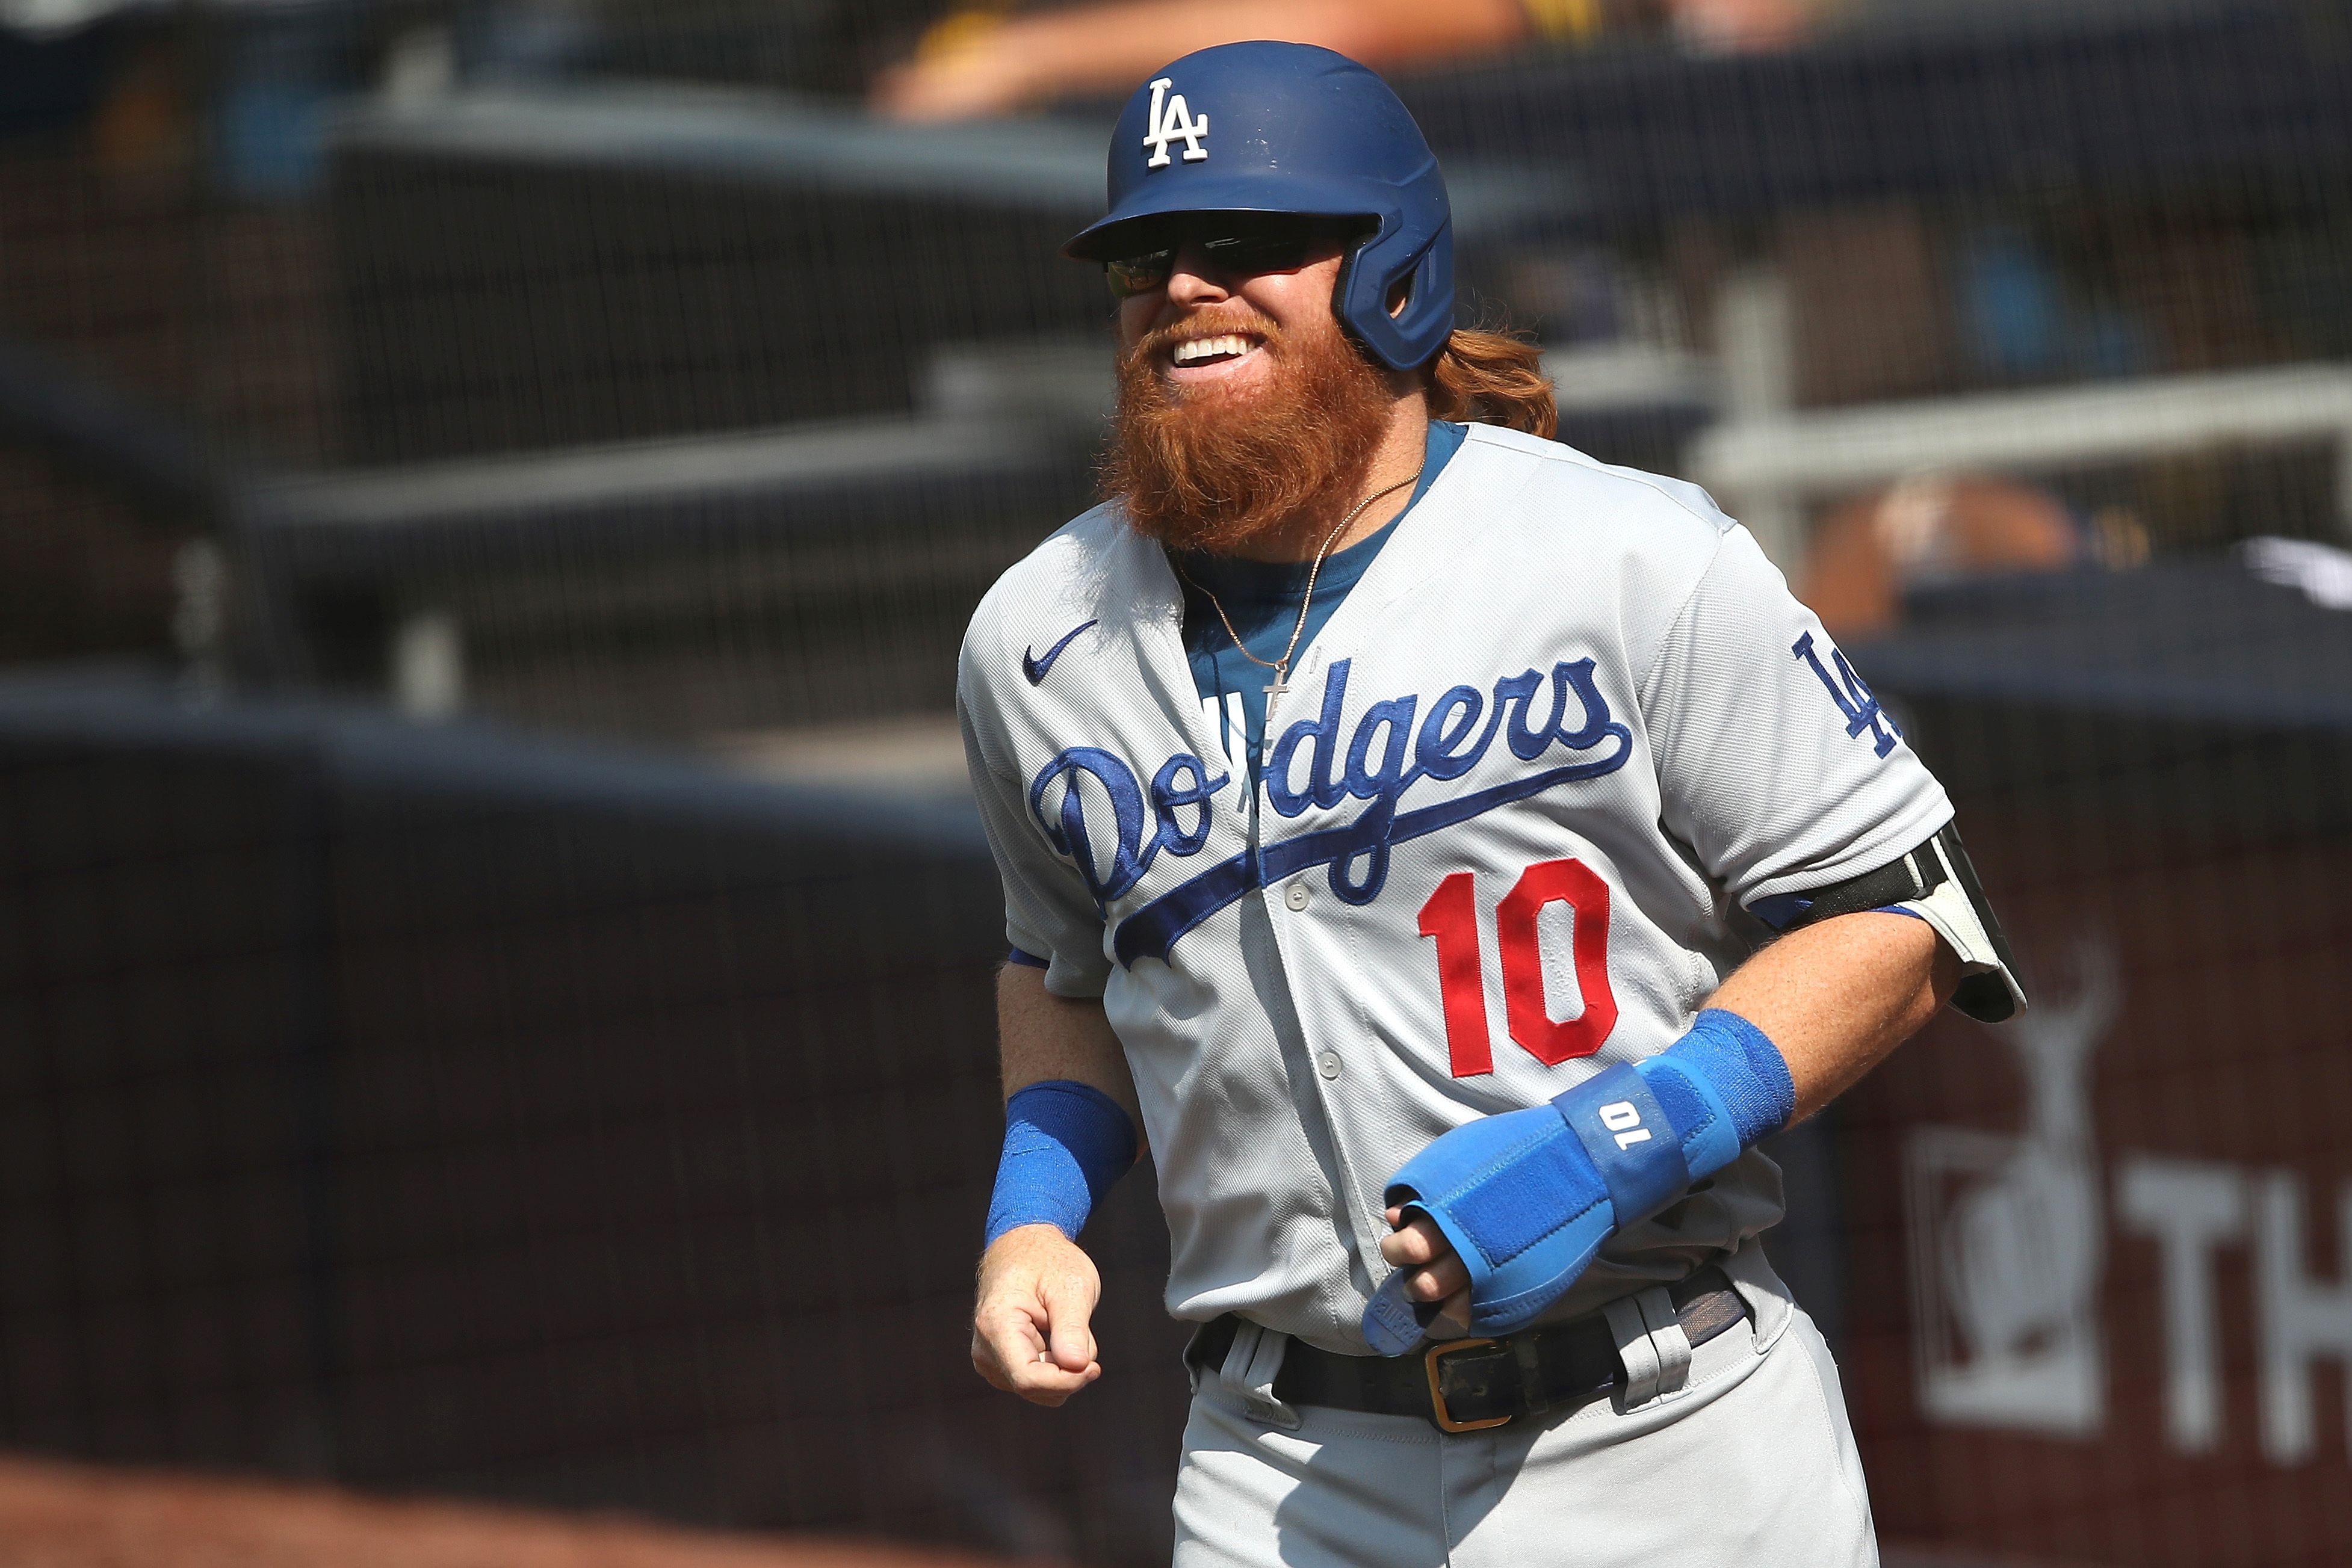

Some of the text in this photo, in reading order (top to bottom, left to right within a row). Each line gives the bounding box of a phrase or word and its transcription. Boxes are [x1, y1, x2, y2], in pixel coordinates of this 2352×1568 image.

[1143, 78, 1208, 168] LA
[1031, 656, 1632, 919] Dodgers
[1417, 858, 1618, 1078] 10
[1598, 1100, 1652, 1151] 10
